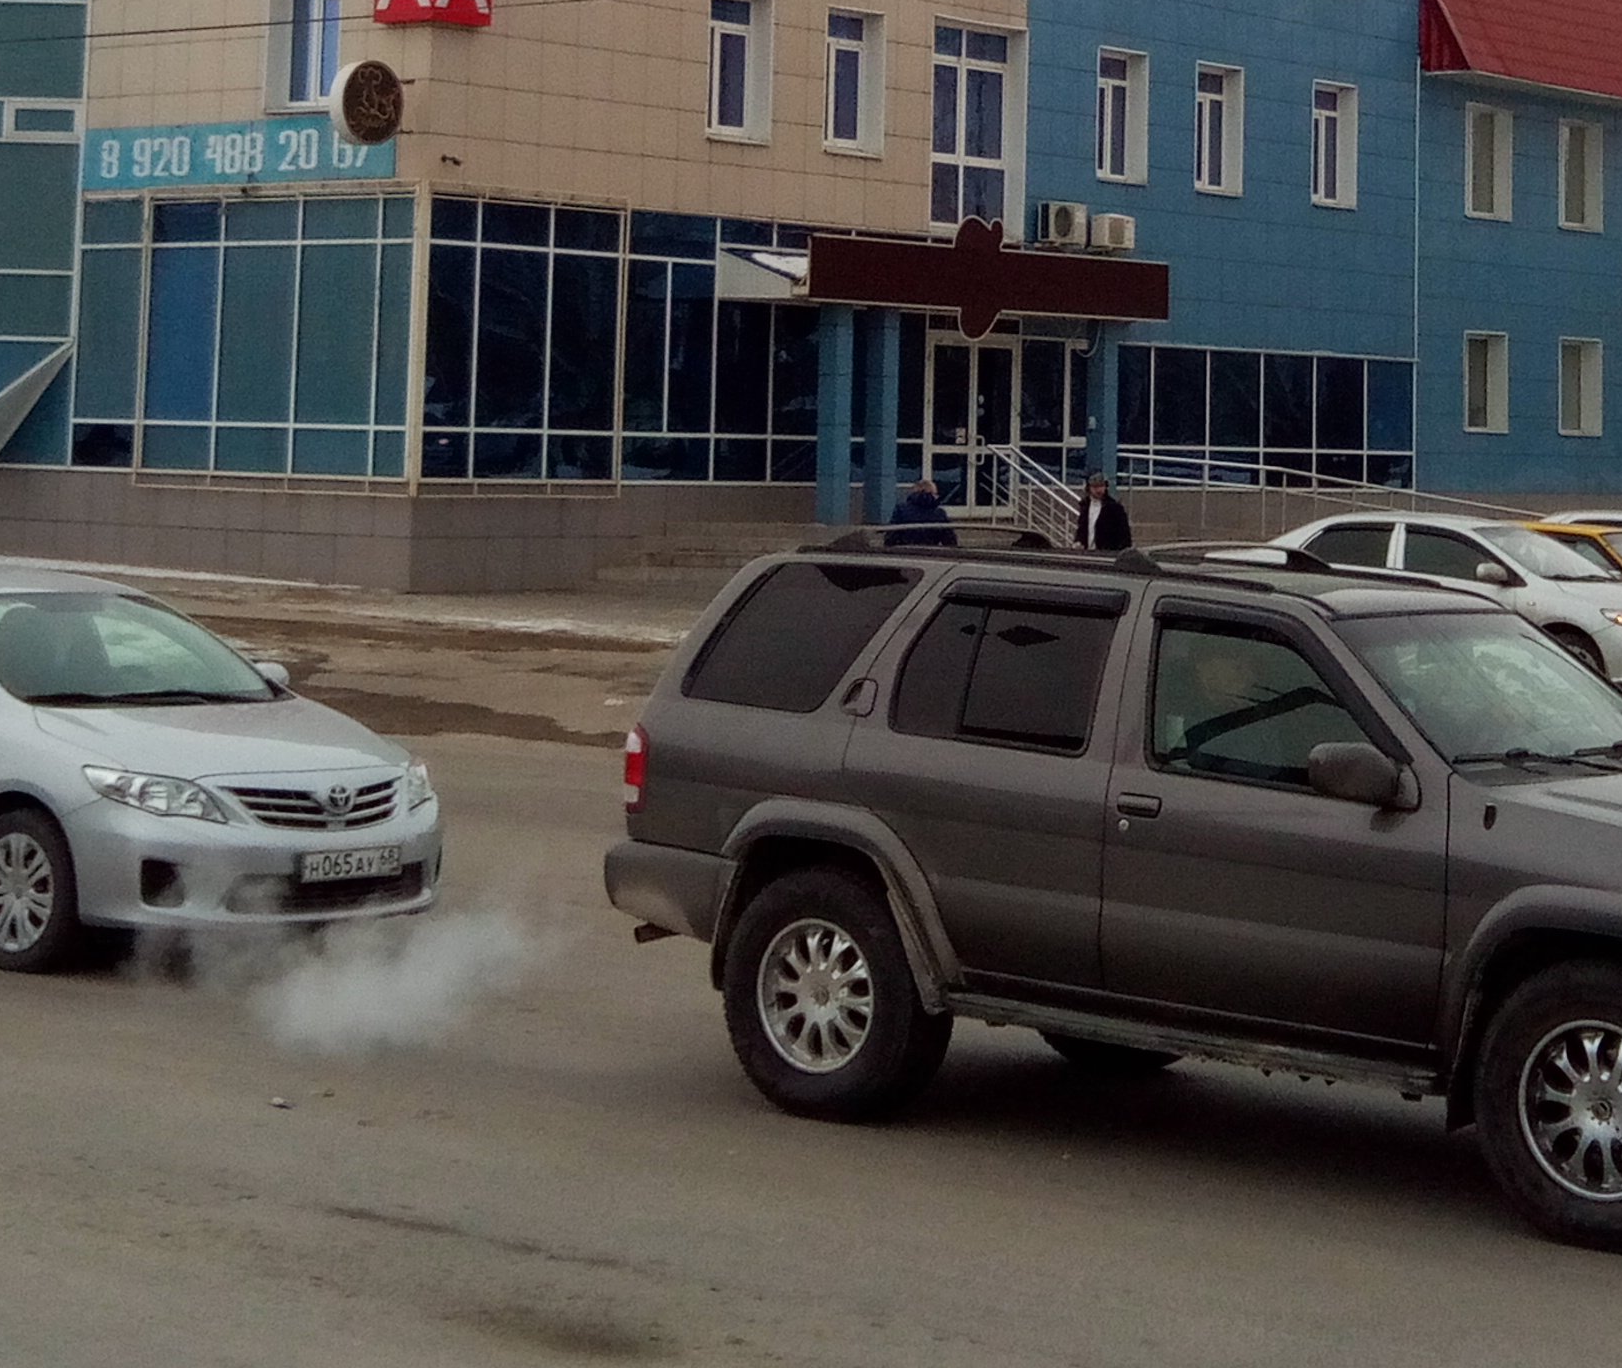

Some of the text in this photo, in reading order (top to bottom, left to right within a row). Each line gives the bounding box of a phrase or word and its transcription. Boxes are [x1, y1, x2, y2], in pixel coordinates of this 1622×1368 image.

[100, 139, 120, 178] 8
[132, 136, 191, 177] 920
[278, 129, 319, 171] 20
